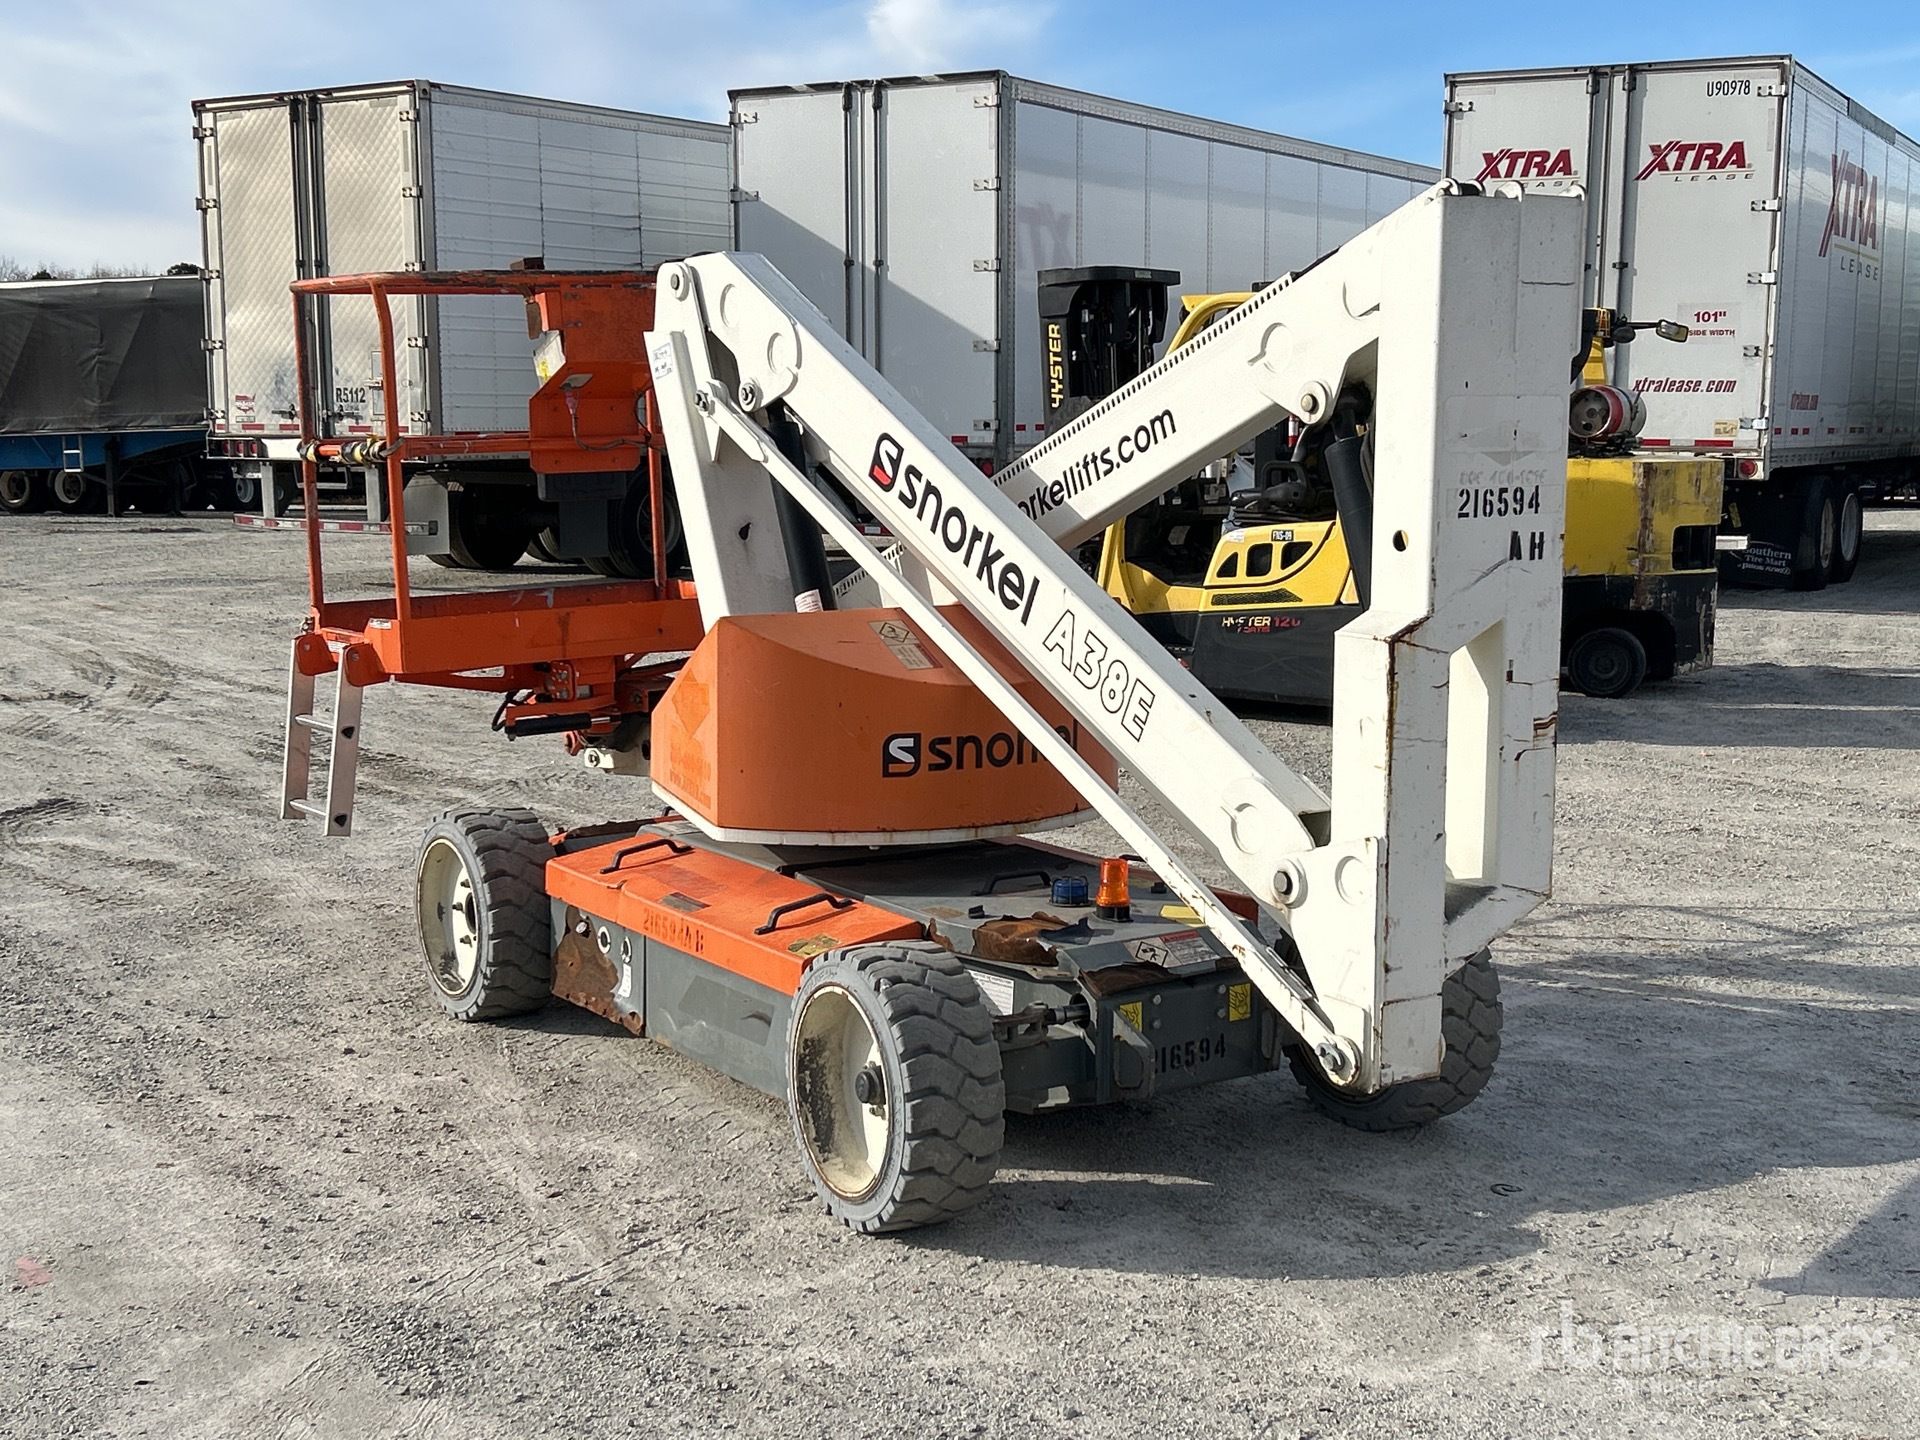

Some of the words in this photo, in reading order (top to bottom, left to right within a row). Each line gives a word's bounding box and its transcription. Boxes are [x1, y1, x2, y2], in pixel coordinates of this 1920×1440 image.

[1706, 80, 1751, 97] U90978
[1475, 148, 1574, 182] XTRA
[1634, 140, 1748, 181] XTRA
[1674, 173, 1754, 183] LEASE
[1818, 149, 1878, 257] XTRA
[1840, 255, 1879, 281] LEASE
[1709, 328, 1735, 337] WIDTH
[335, 387, 366, 404] R5112
[1632, 376, 1737, 394] xtralease.com
[1457, 484, 1541, 519] 216594
[898, 463, 1041, 627] snorkel
[1042, 608, 1156, 743] A38E
